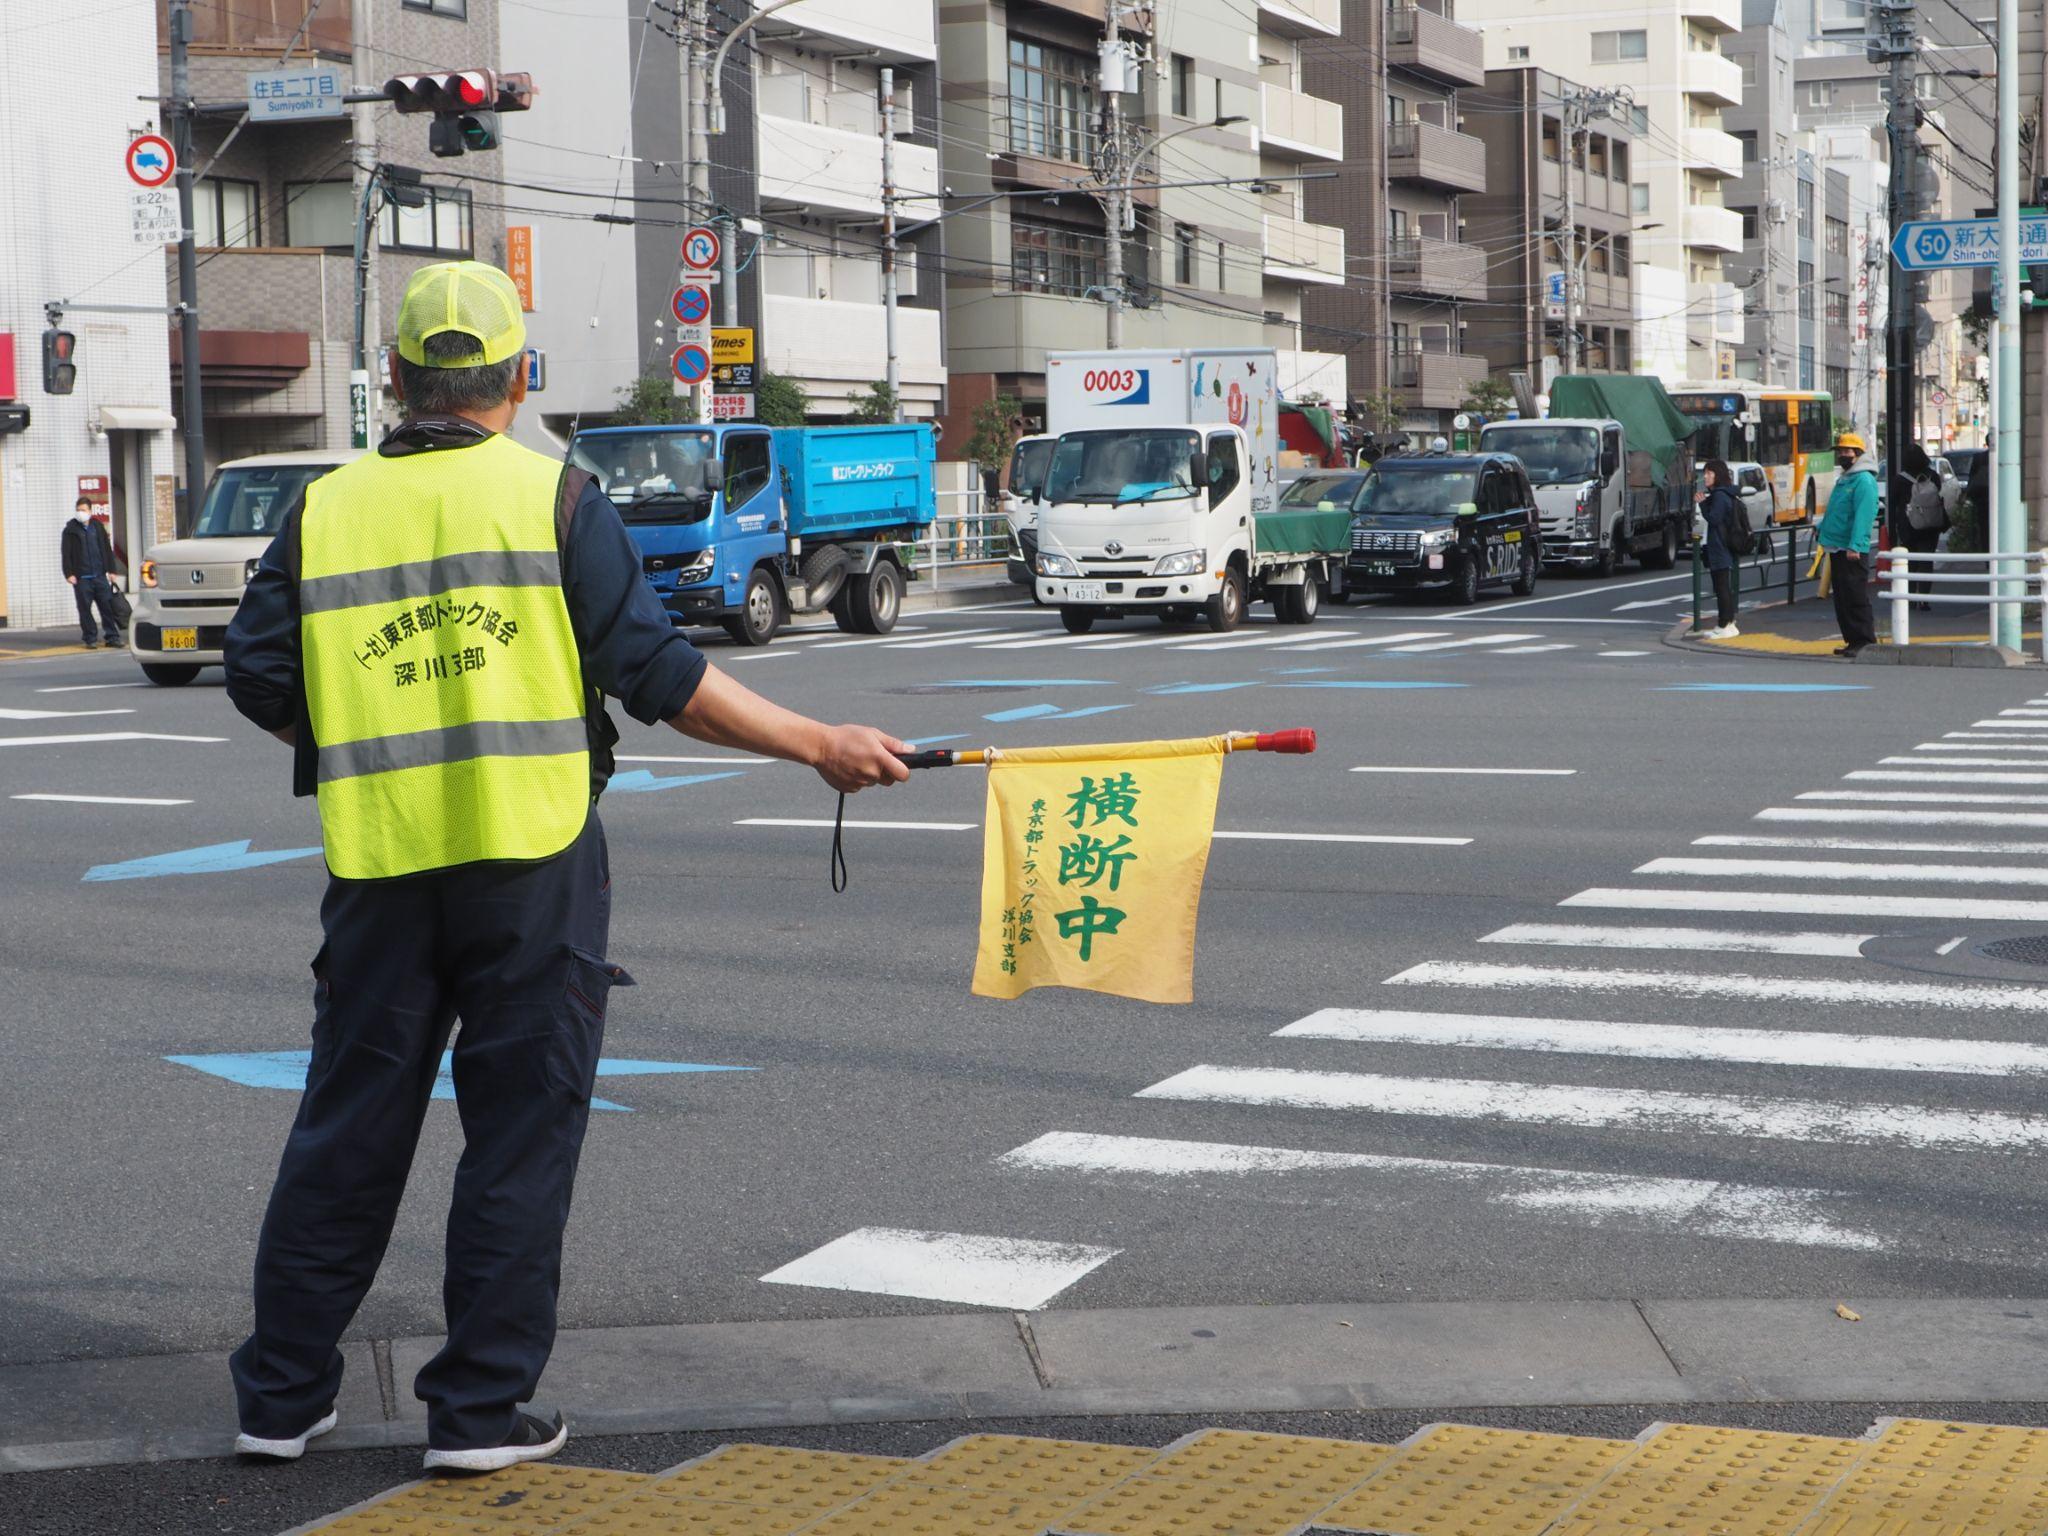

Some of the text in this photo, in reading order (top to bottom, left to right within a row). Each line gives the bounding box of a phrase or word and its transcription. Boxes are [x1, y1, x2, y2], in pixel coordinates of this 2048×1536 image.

[254, 75, 333, 99] 住吉二丁目
[268, 98, 323, 112] Sumiyoshi 2
[1921, 234, 1946, 256] 50
[733, 366, 751, 385] 空
[1084, 370, 1133, 391] 0003
[1018, 798, 1047, 945] 東京都トラック協会
[1054, 772, 1141, 961] 横断中
